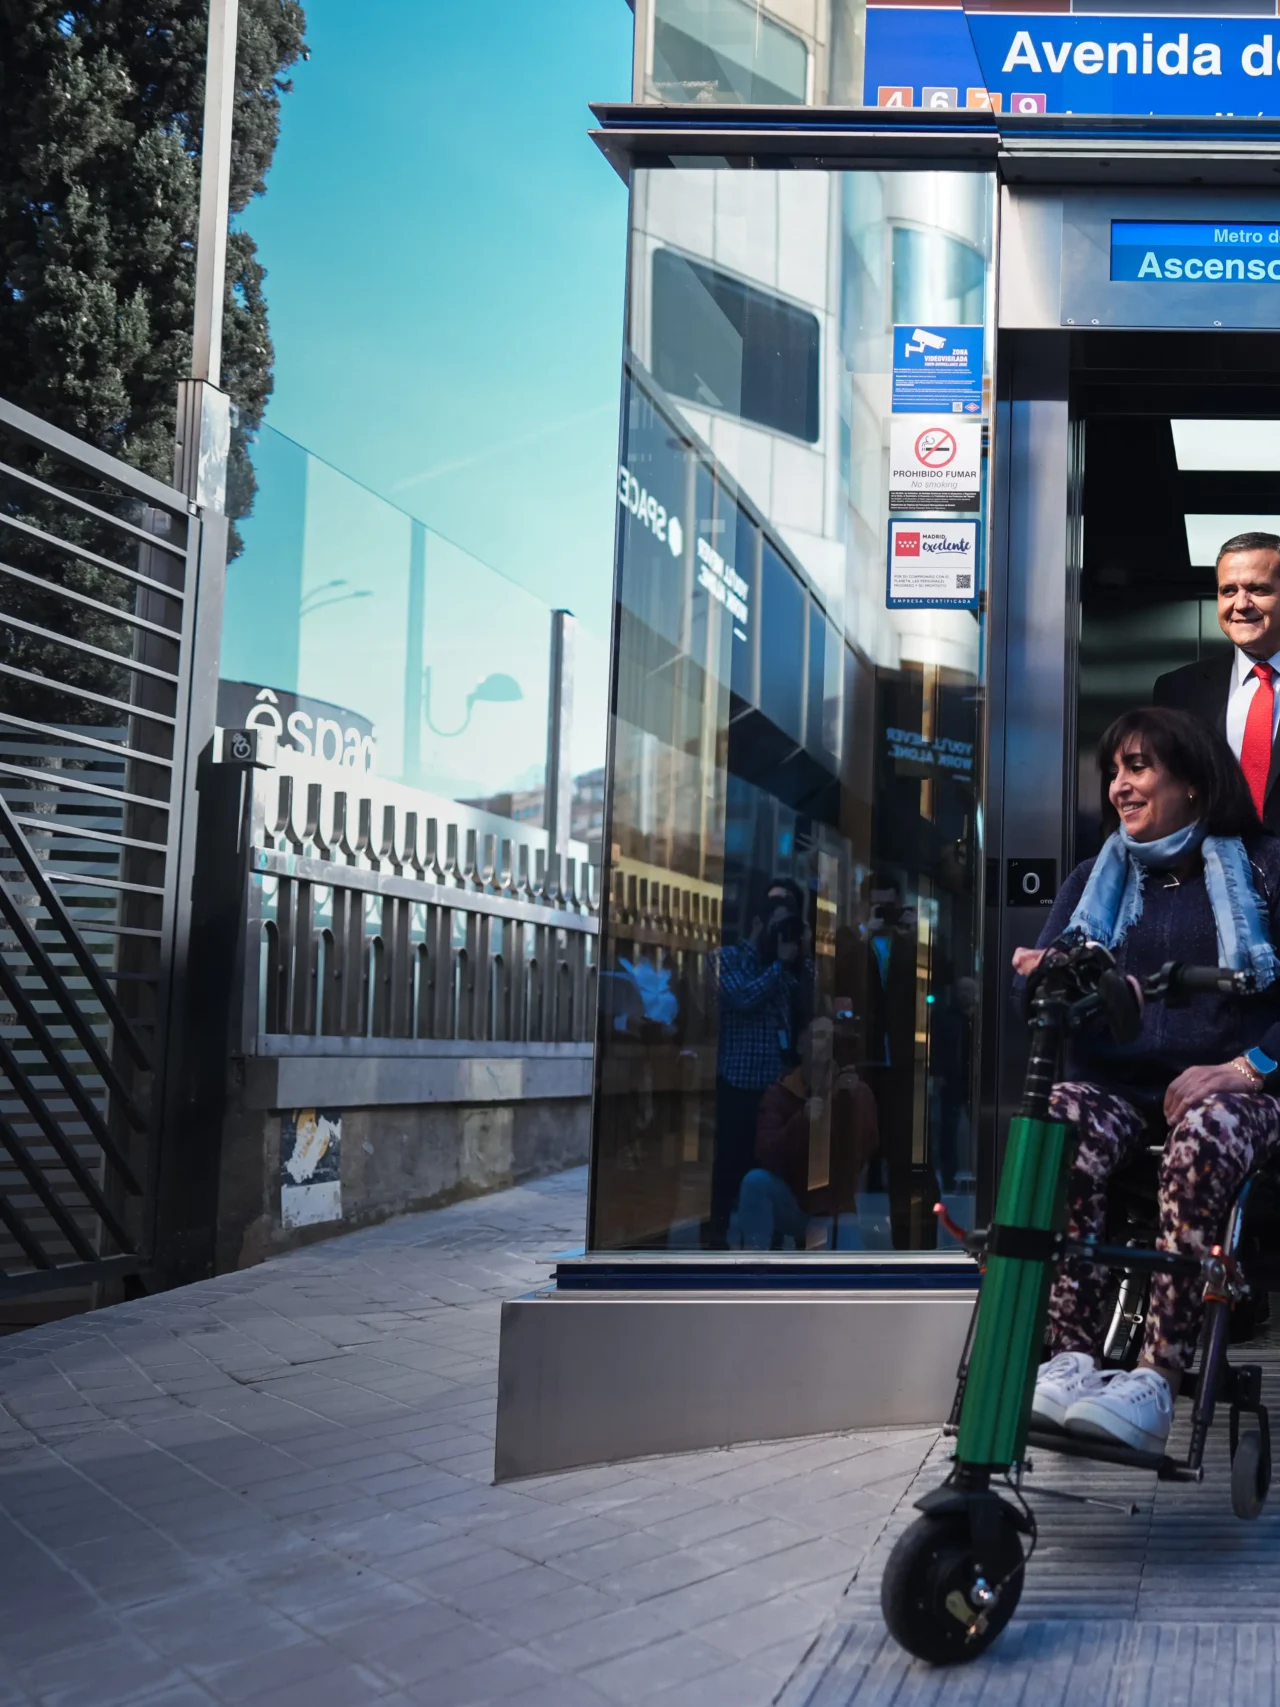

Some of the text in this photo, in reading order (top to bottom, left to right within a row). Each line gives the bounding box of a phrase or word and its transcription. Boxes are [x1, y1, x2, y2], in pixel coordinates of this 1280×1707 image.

[1002, 31, 1222, 76] Avenida
[1213, 229, 1263, 244] Metro
[893, 470, 977, 478] PROHIBIDO FUMAR
[924, 481, 958, 489] smoking
[922, 538, 971, 553] excelente
